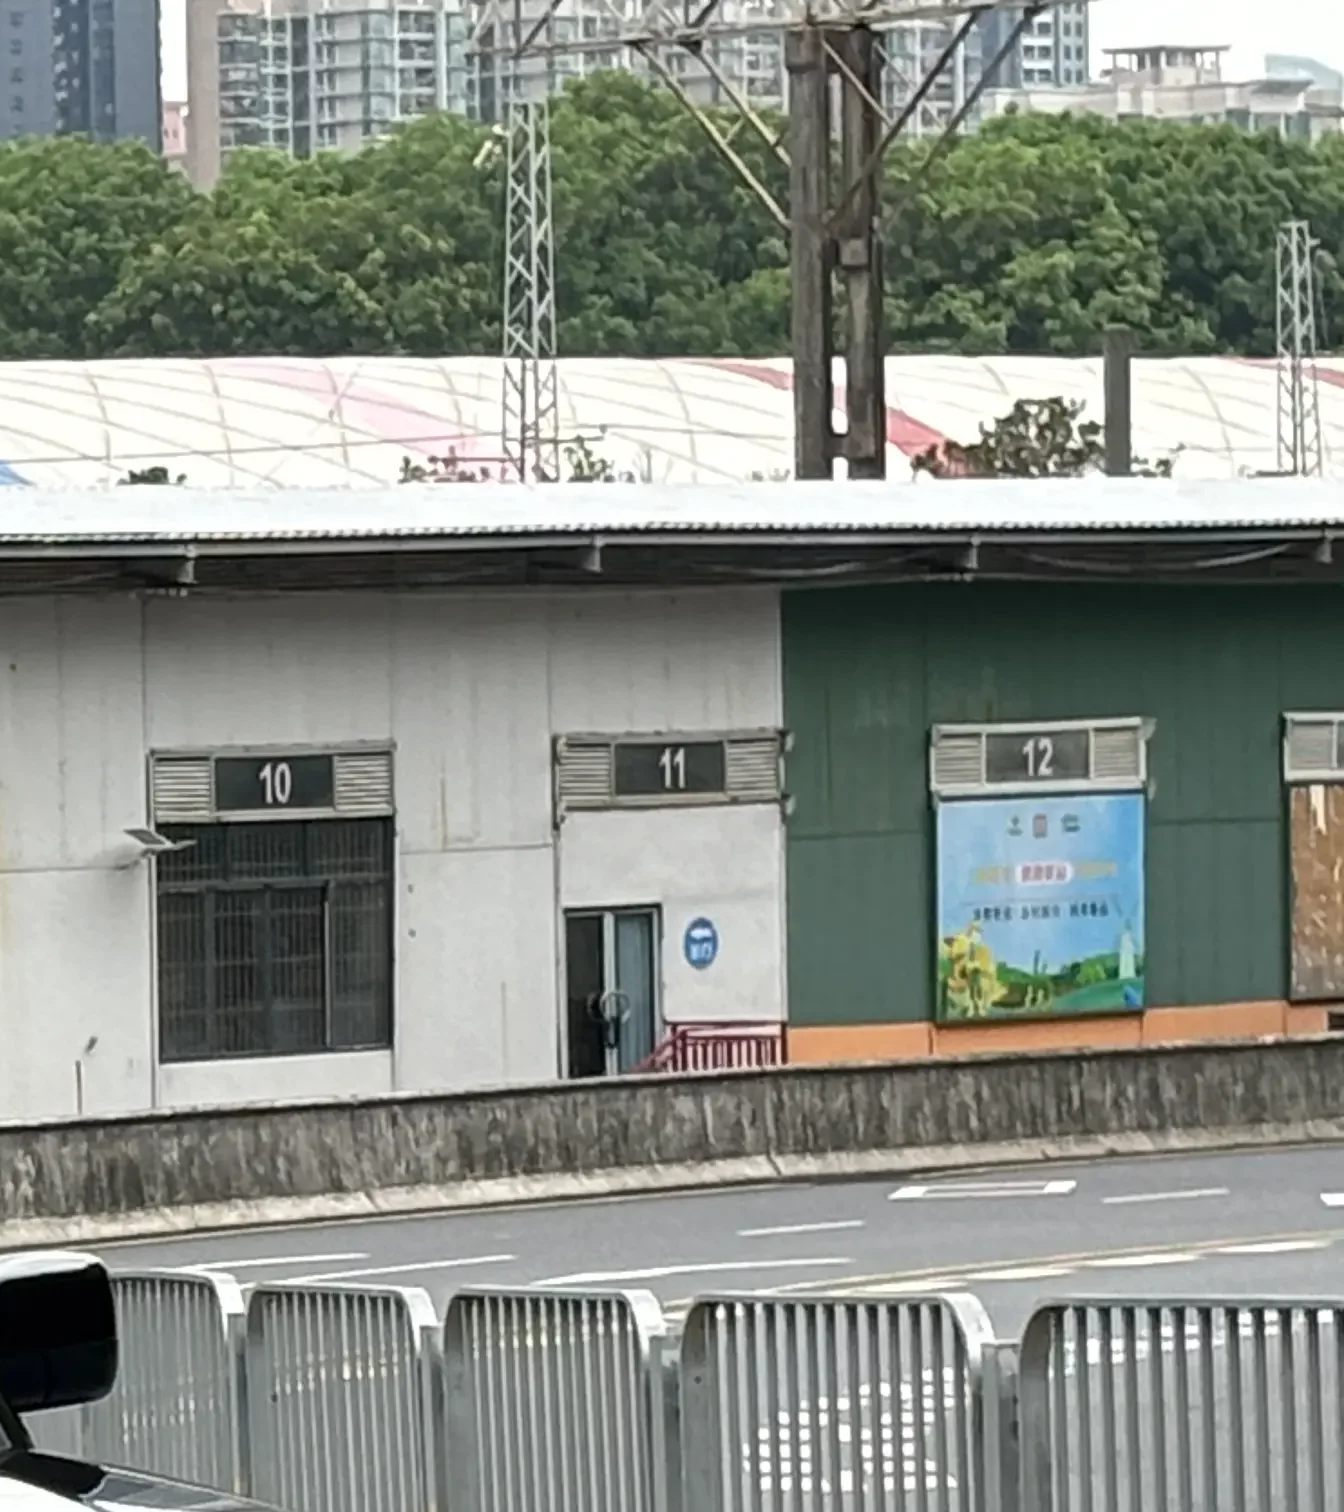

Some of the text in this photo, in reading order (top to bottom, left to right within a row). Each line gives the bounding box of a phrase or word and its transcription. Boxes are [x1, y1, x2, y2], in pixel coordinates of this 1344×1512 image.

[659, 747, 686, 789] 11
[1023, 736, 1053, 776] 12
[258, 762, 292, 804] 10
